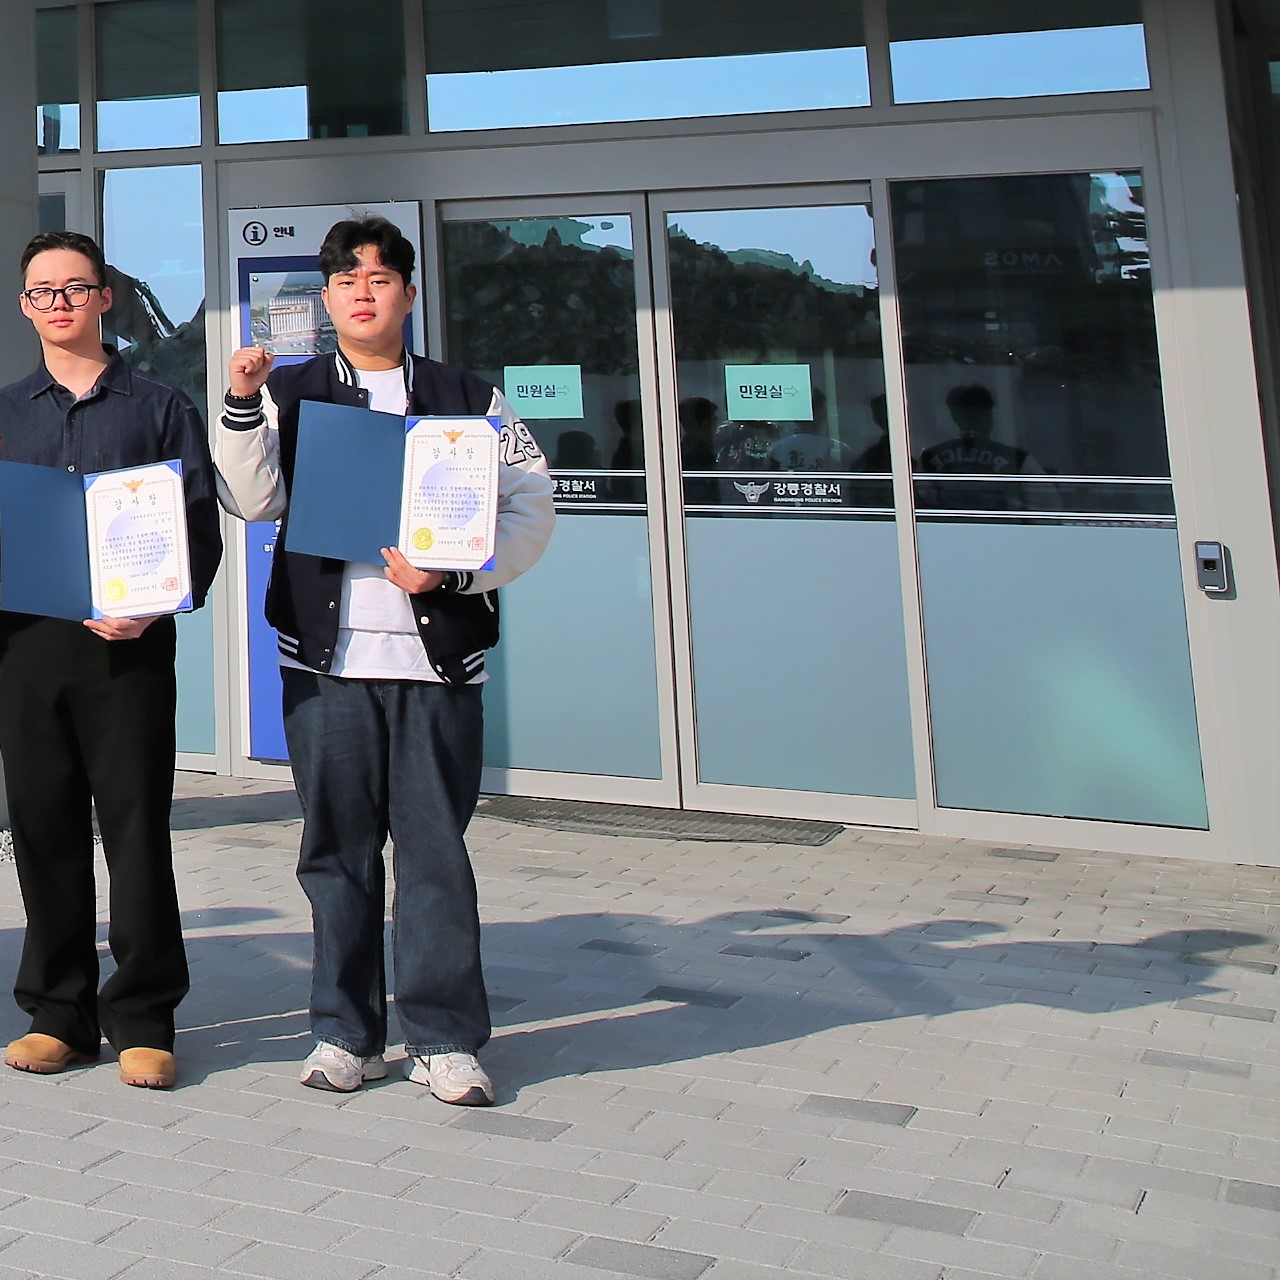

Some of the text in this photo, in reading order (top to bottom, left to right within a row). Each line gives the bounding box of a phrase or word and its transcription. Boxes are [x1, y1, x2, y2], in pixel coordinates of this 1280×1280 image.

[273, 226, 295, 237] 안내
[517, 384, 556, 398] 민원실
[739, 384, 783, 399] 민원실
[500, 421, 541, 466] 29
[773, 483, 840, 495] 강릉경찰서
